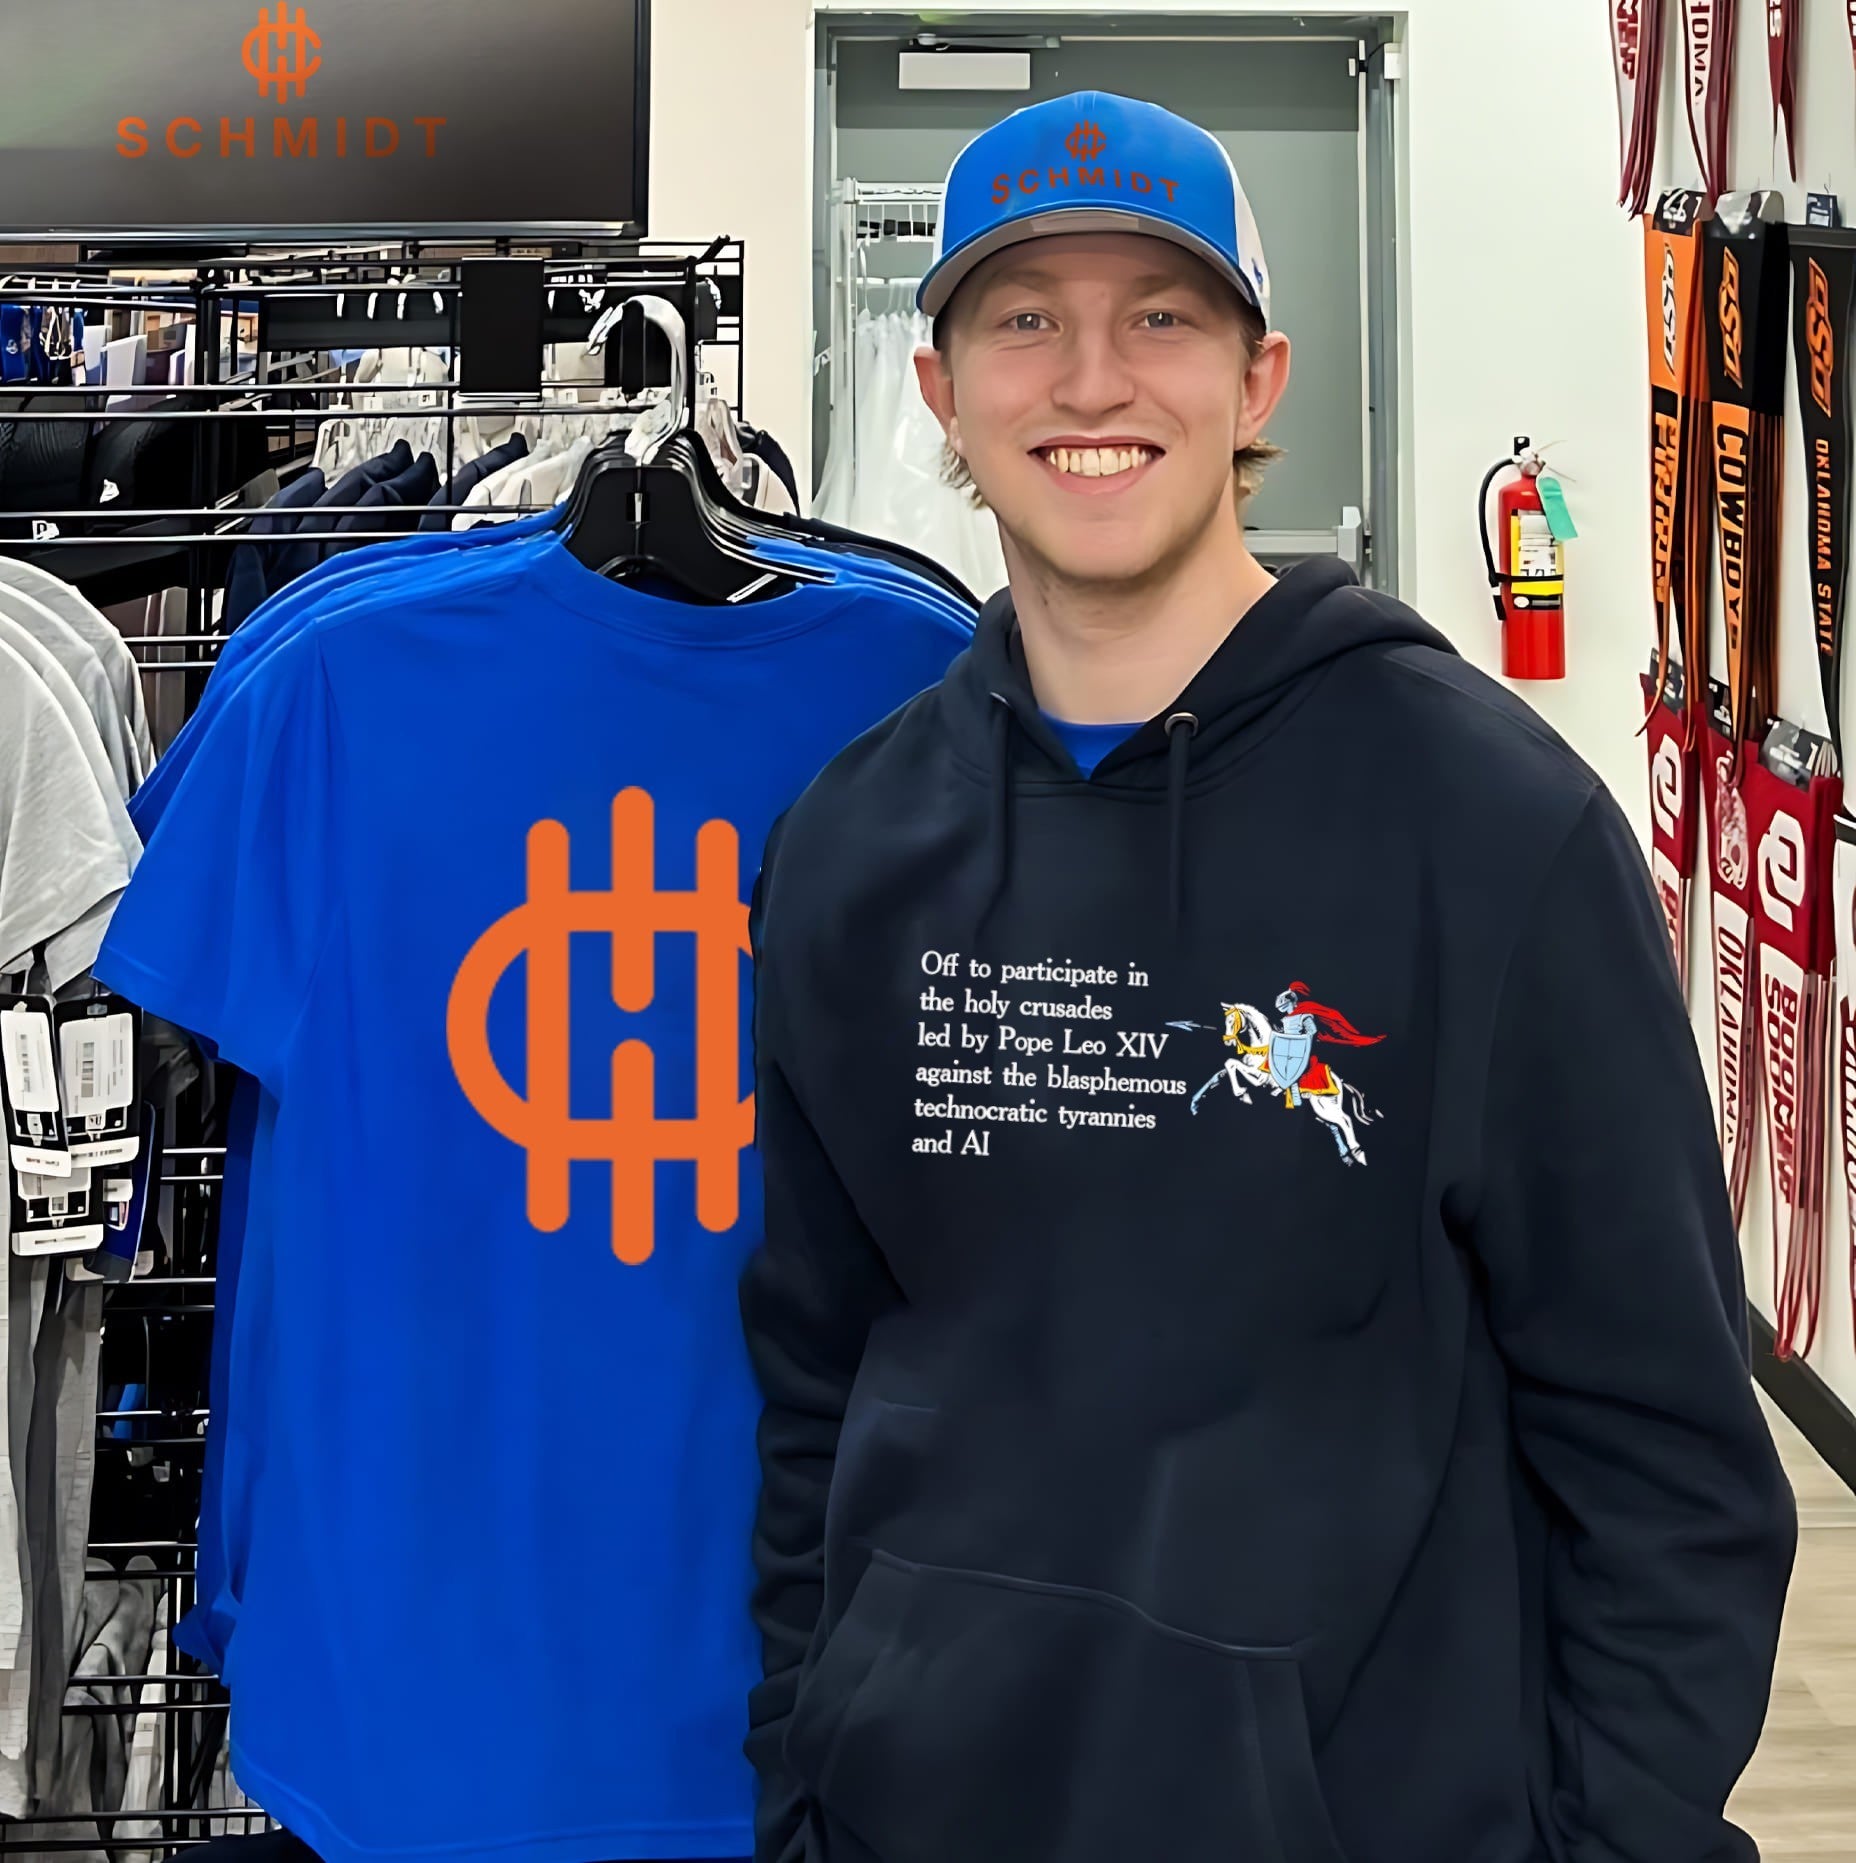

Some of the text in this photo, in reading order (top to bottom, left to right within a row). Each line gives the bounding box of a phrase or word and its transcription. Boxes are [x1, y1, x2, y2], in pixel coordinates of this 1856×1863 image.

[116, 117, 447, 158] SCHMIDT
[991, 166, 1179, 204] SCHMIDT
[1815, 439, 1832, 570] OKLAHOMA
[920, 950, 1148, 987] Off to participate in
[920, 986, 1112, 1020] the holy crusades
[918, 1022, 1169, 1059] led by Pope Leo XIV
[1718, 925, 1744, 1143] OKLAHOMA
[915, 1059, 1187, 1096] against the blasphemous
[914, 1094, 1156, 1130] technocratic tyrannies
[912, 1130, 990, 1156] and AI
